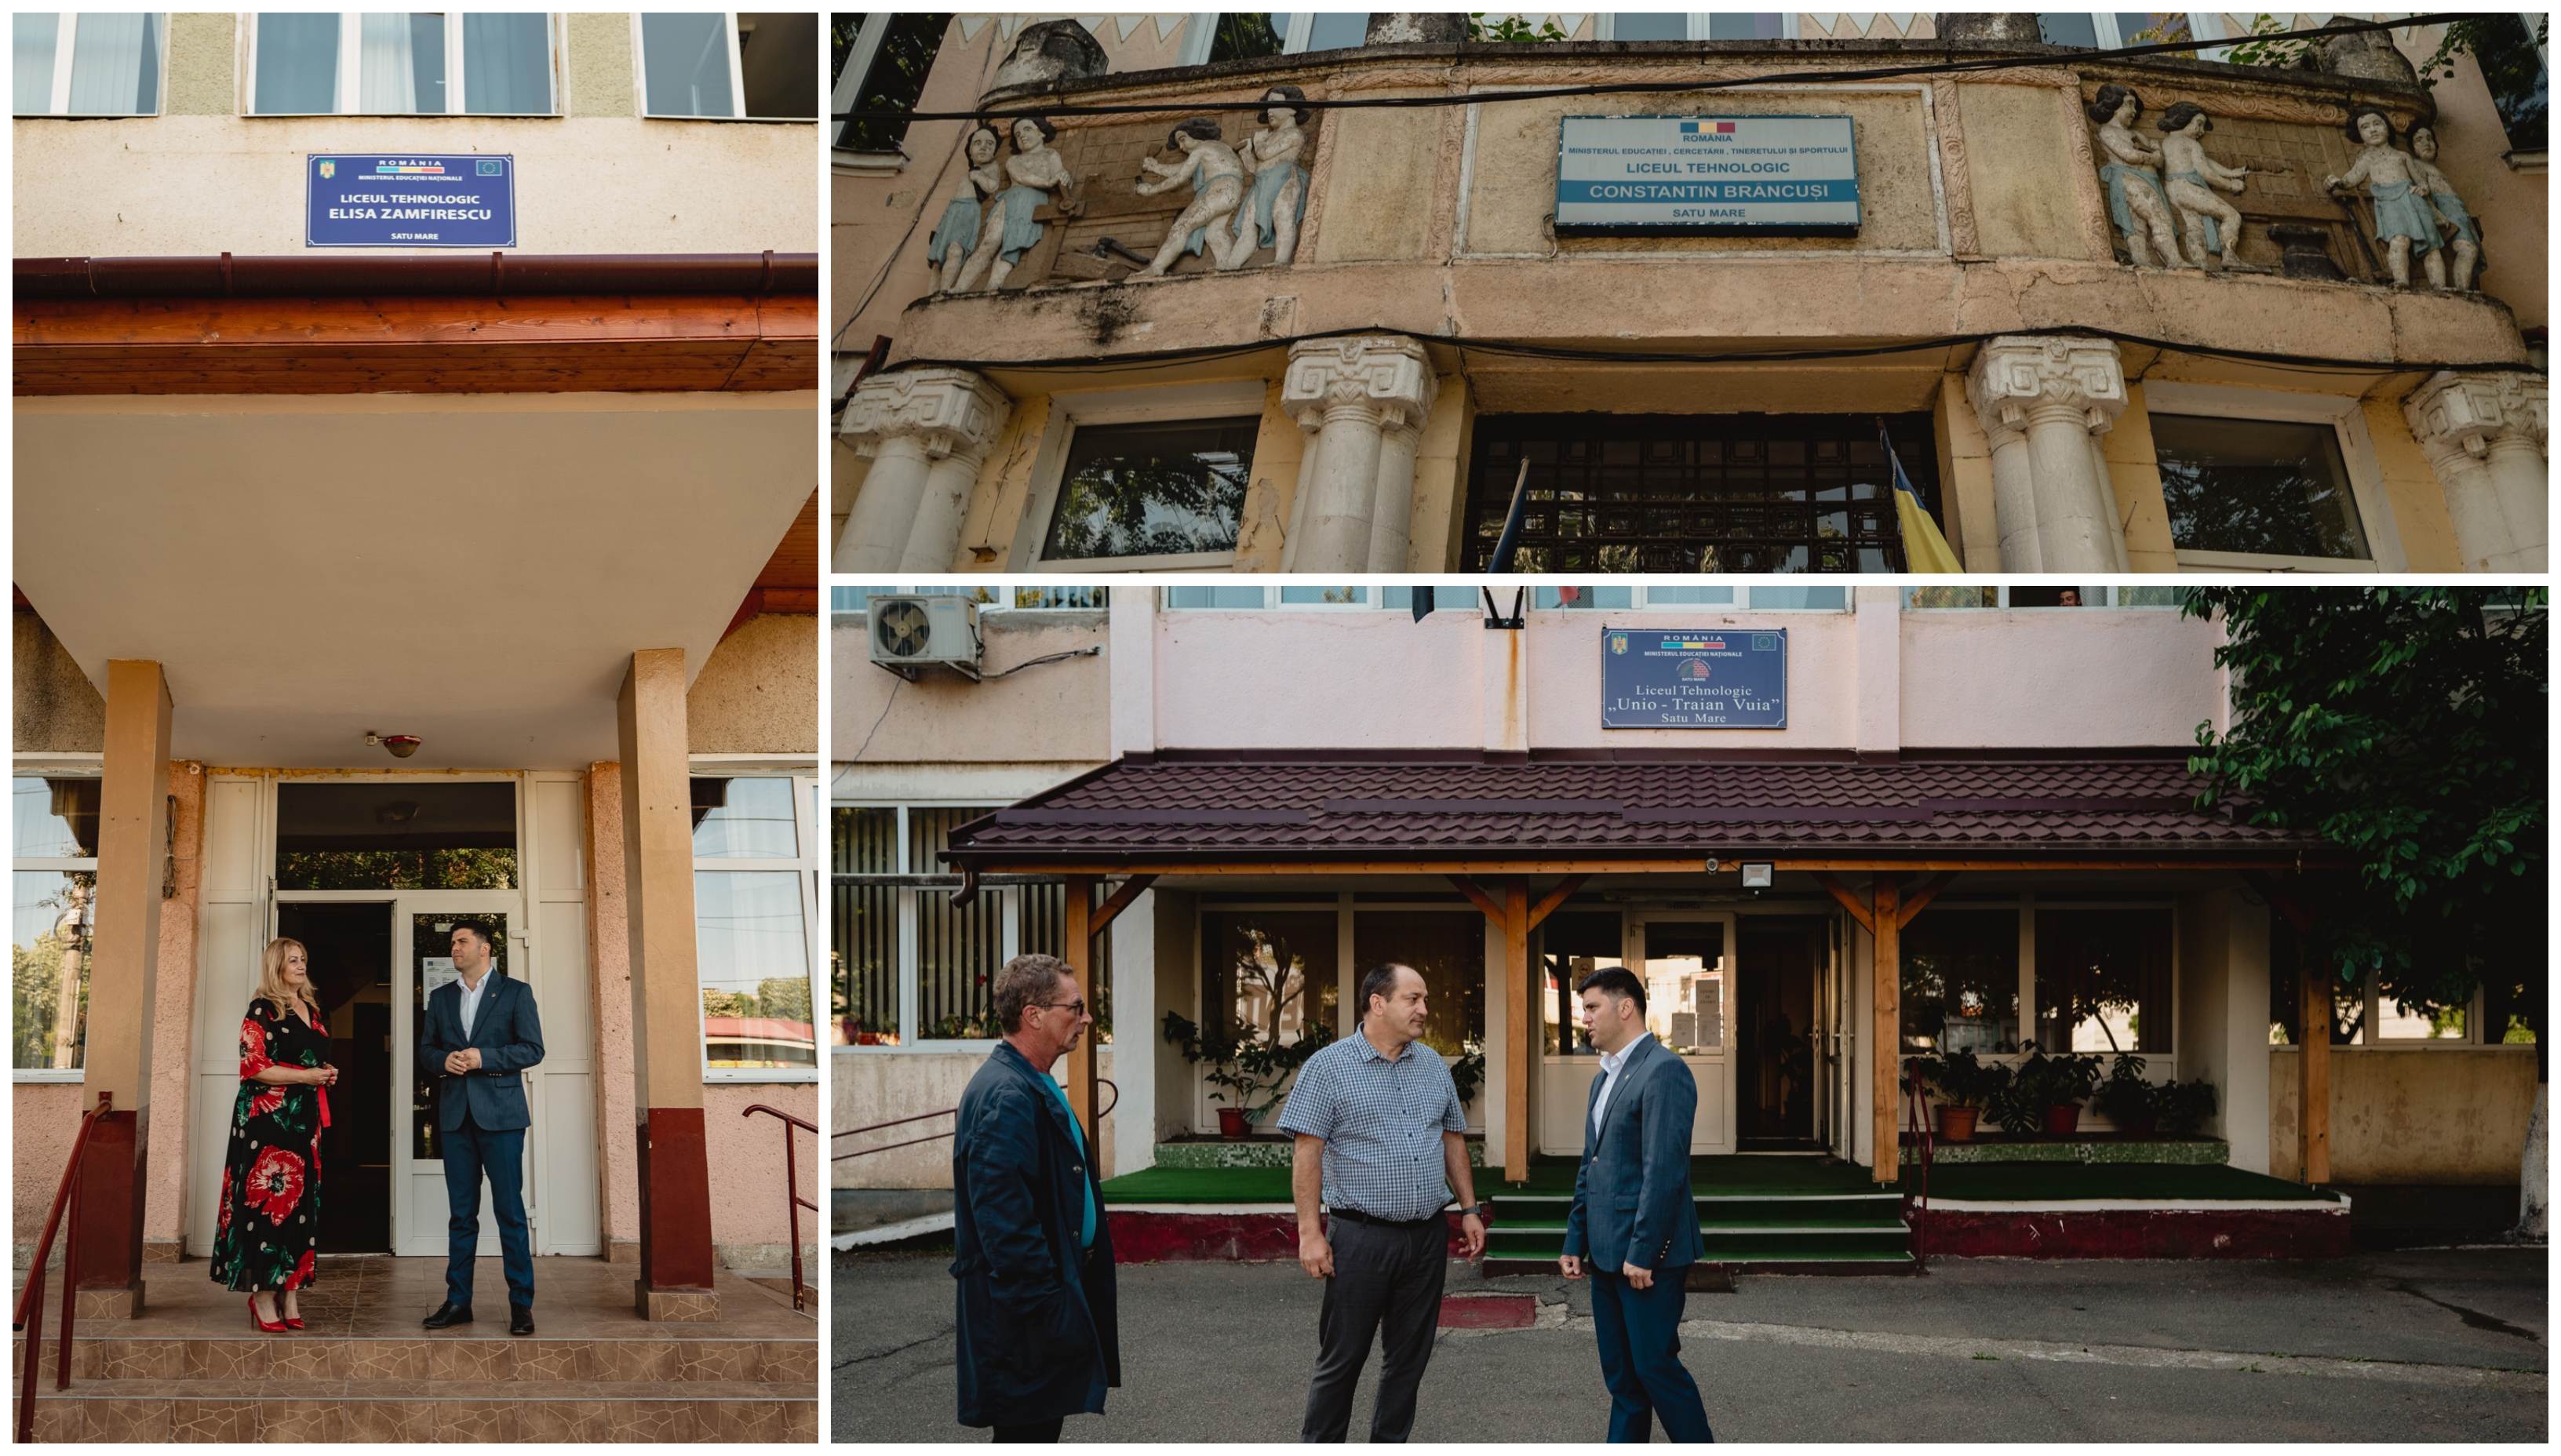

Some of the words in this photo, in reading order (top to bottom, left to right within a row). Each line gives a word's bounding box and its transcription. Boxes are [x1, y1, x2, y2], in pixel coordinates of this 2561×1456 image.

[1682, 133, 1732, 143] ROMÂNIA
[1627, 162, 1682, 173] LICEUL
[1686, 162, 1790, 173] TEHNOLOGIC
[1589, 185, 1718, 198] CONSTANTIN
[1724, 182, 1828, 201] BRÂNCUȘI
[341, 195, 388, 203] LICEUL
[390, 195, 480, 204] TEHNOLOGIC
[329, 209, 377, 219] ELISA
[381, 209, 491, 220] ZAMFIRESCU
[1673, 209, 1706, 217] SATU
[1710, 209, 1746, 217] MARE
[1636, 686, 1676, 695] Liceul
[1680, 686, 1752, 698] Tehnologic
[1672, 698, 1724, 711] Traian
[1662, 713, 1688, 723] Satu
[1696, 713, 1726, 723] Mare
